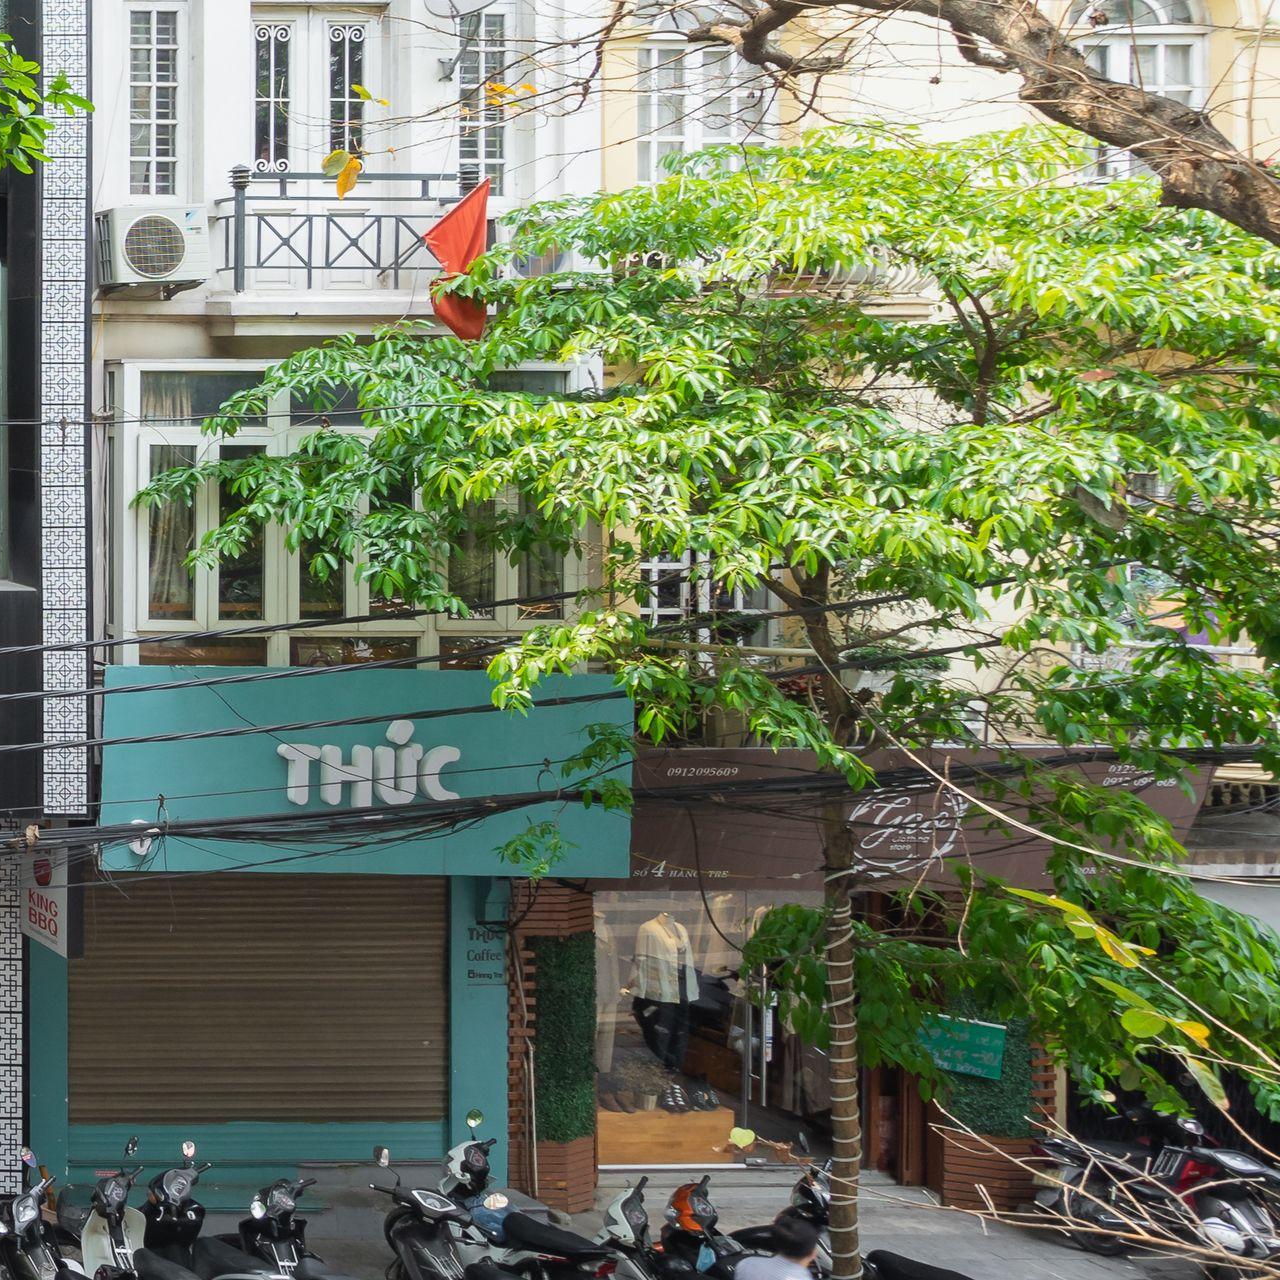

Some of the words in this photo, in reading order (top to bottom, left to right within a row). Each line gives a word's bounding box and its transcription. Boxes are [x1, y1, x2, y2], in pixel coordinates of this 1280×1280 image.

[667, 767, 739, 777] 0912095609
[651, 860, 666, 878] 4
[28, 887, 58, 918] KING
[28, 907, 58, 938] BBQ
[467, 948, 503, 961] Coffee
